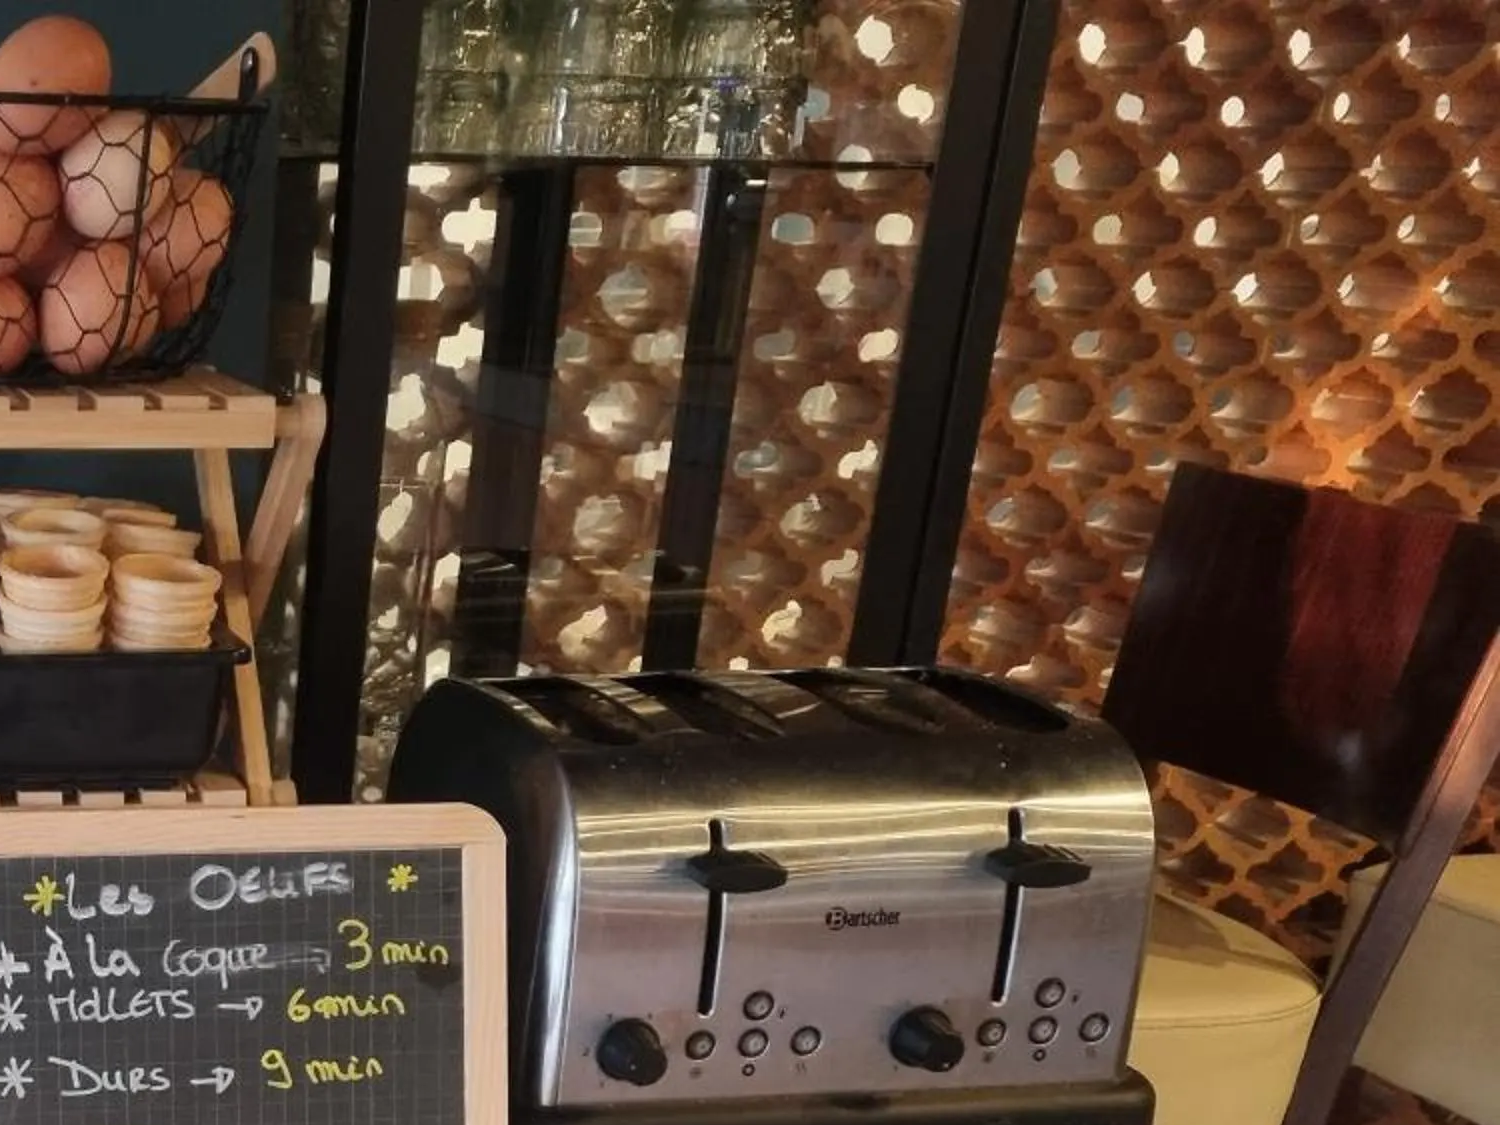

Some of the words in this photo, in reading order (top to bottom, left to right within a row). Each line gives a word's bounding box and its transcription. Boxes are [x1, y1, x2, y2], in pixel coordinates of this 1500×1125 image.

[64, 873, 154, 919] Les
[825, 905, 901, 931] Bartscher
[337, 917, 372, 971] 3
[381, 940, 450, 966] min
[261, 1048, 293, 1089] 9
[304, 1054, 385, 1083] min
